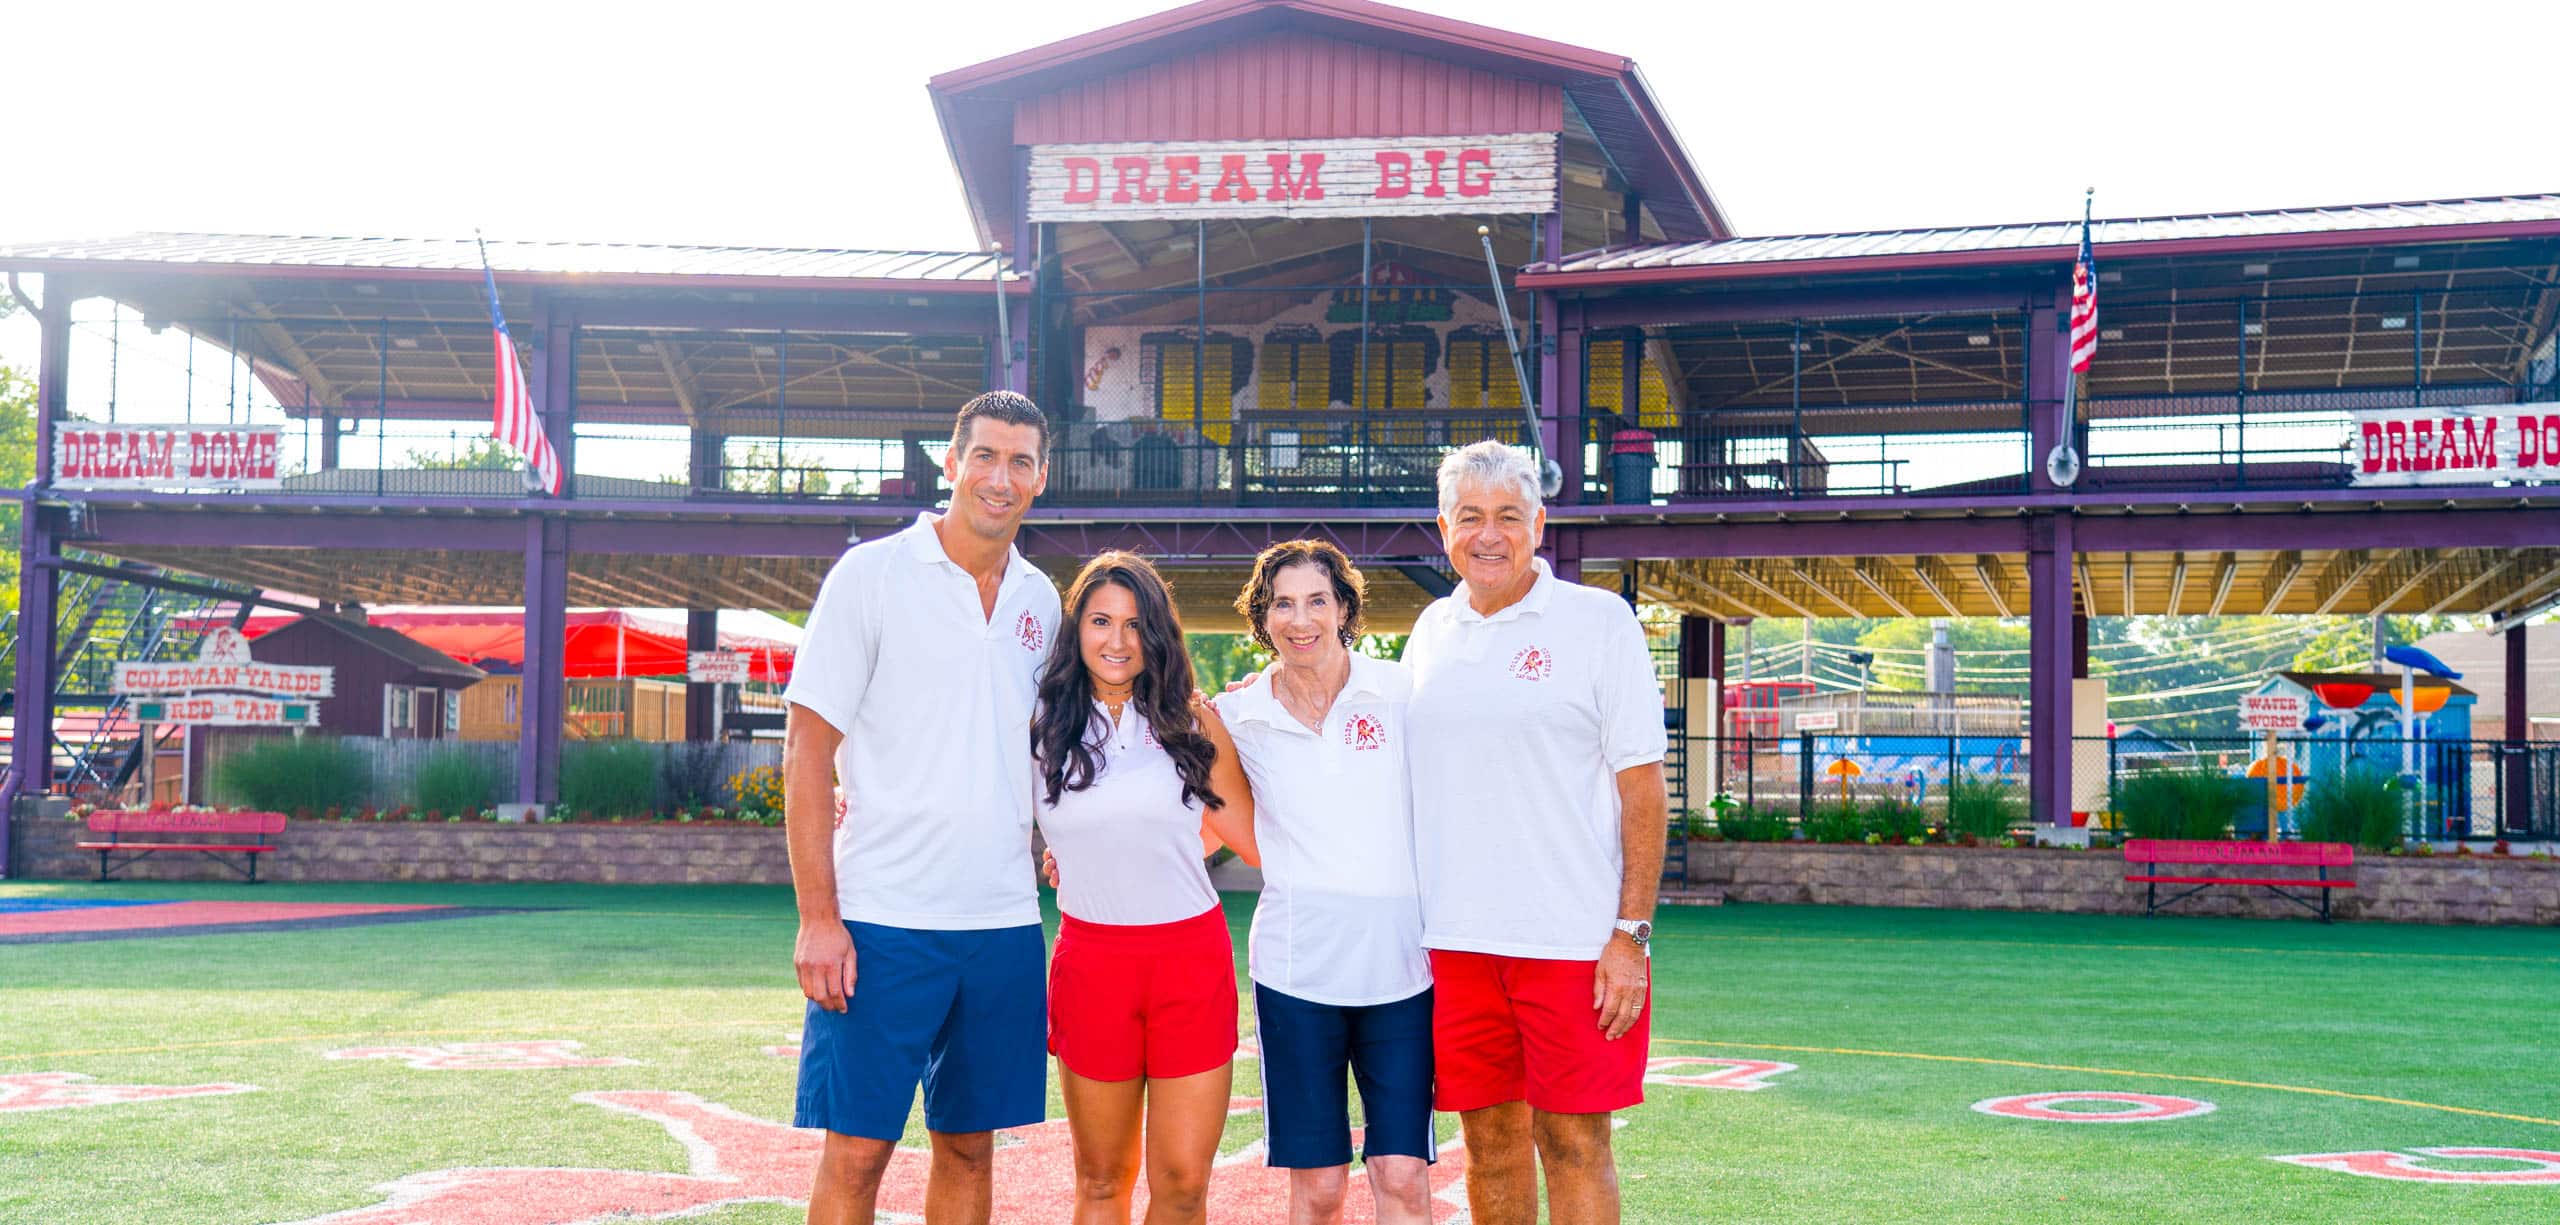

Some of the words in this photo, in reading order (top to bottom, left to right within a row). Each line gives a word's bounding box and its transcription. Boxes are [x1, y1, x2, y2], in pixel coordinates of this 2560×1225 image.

[1063, 153, 1325, 204] DREAM
[1375, 149, 1497, 199] BIG
[62, 431, 176, 478] DREAM
[190, 431, 276, 479] DOME
[2362, 416, 2497, 473] DREAM
[705, 652, 736, 662] THE
[125, 667, 240, 688] COLEMAN
[243, 669, 322, 692] YARDS
[170, 699, 214, 721] RED
[233, 699, 279, 721] TAN
[2248, 697, 2297, 710] WATER
[2248, 715, 2297, 728] WORKS
[2195, 845, 2280, 858] COLEMAN
